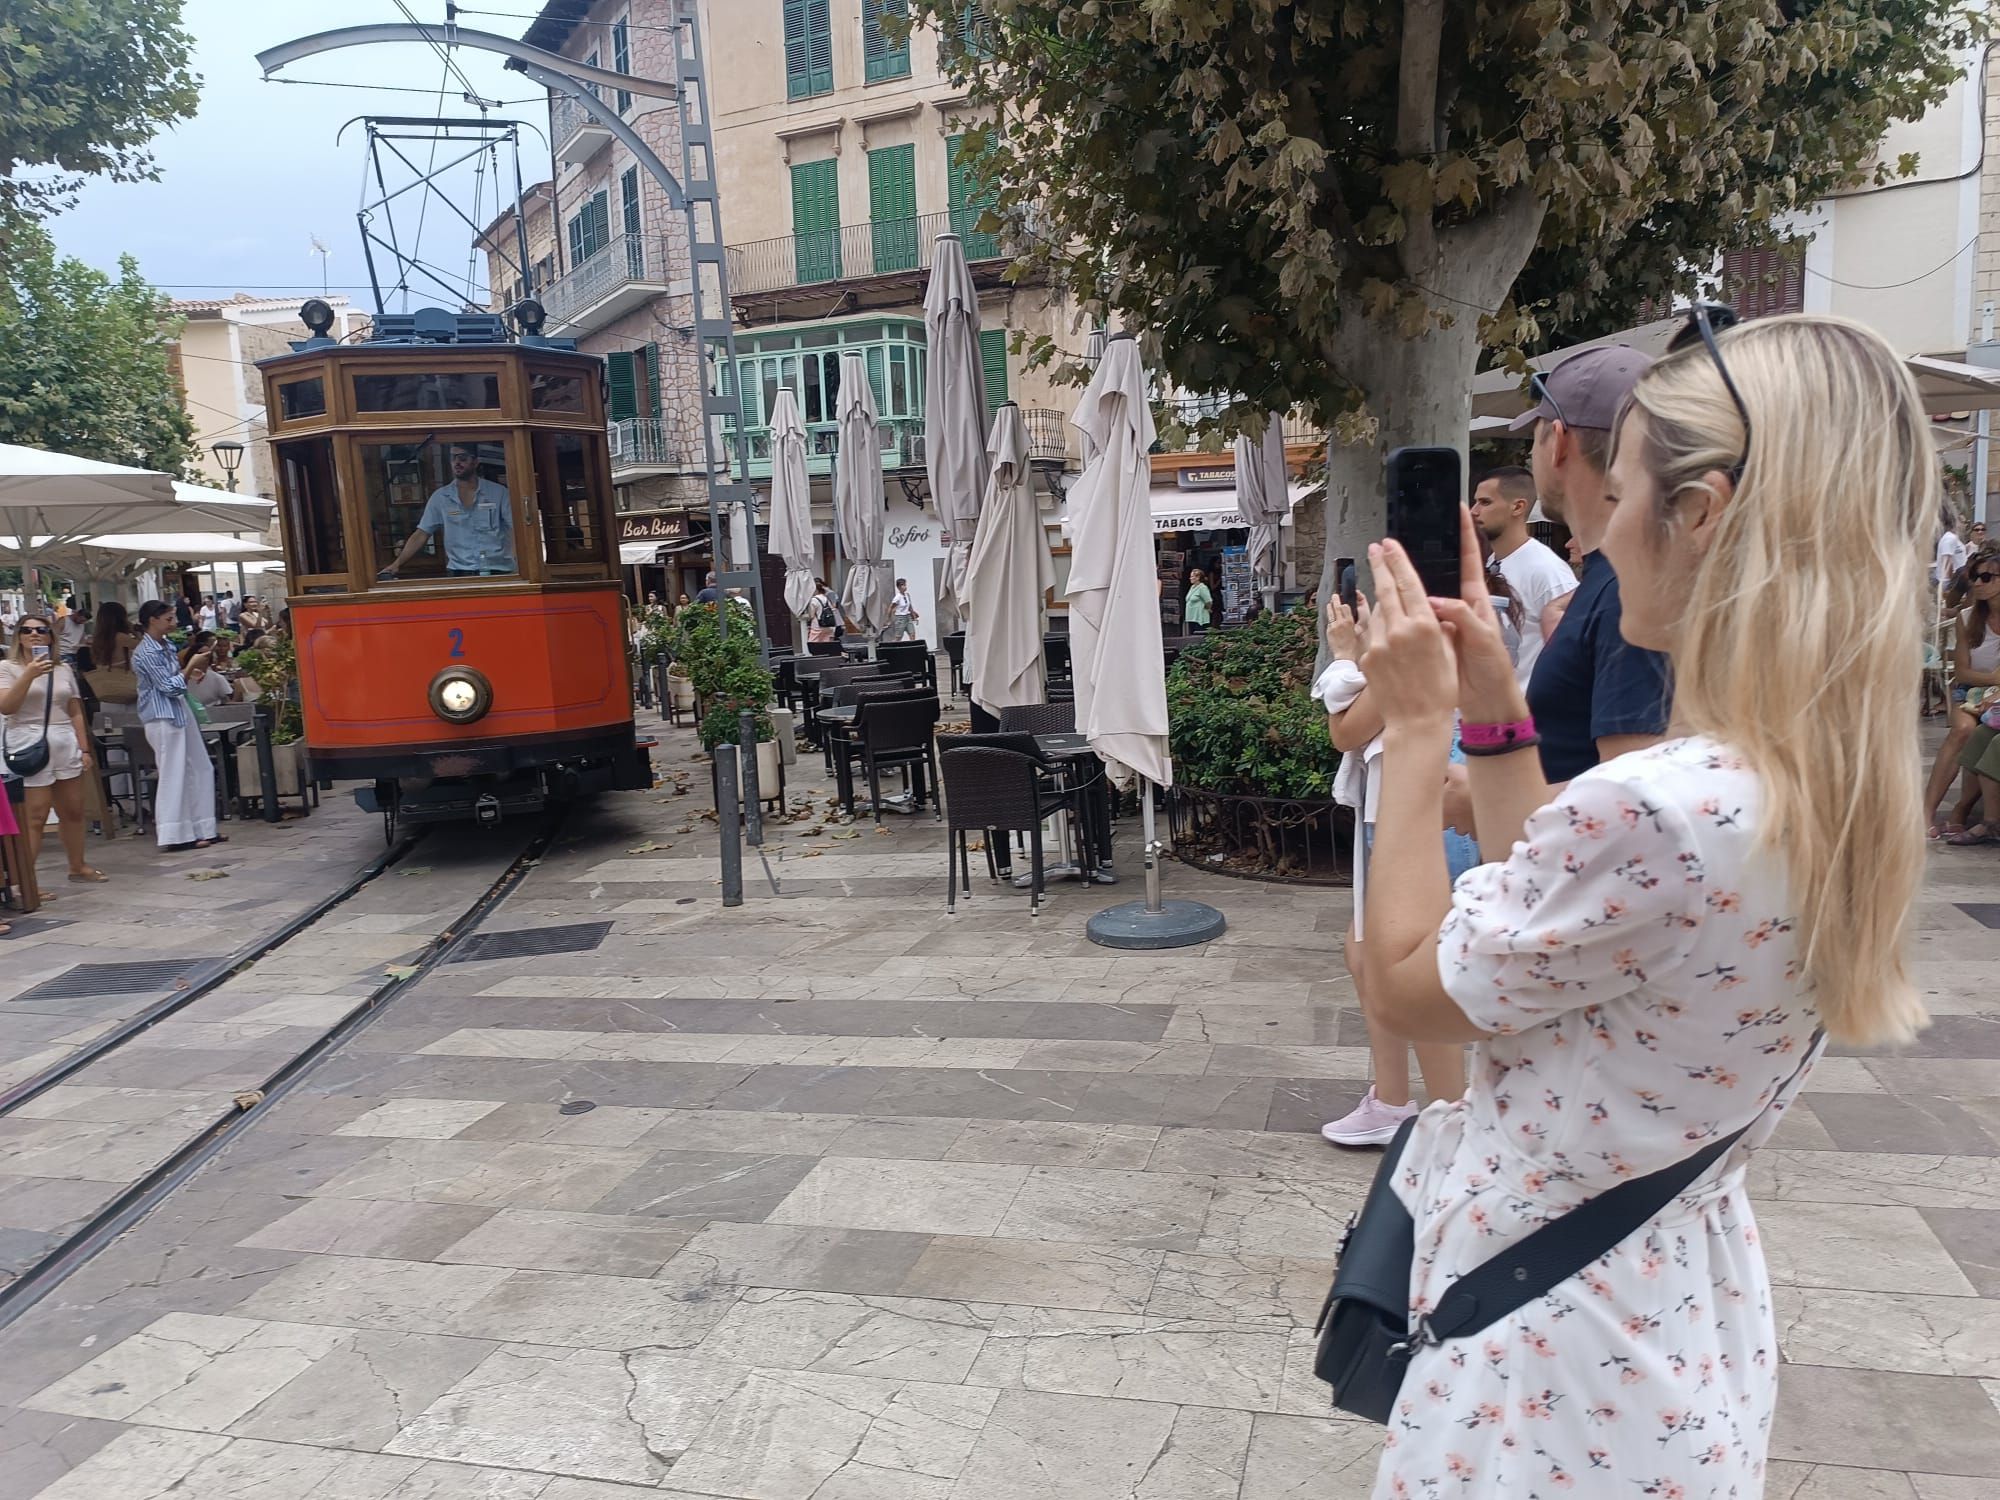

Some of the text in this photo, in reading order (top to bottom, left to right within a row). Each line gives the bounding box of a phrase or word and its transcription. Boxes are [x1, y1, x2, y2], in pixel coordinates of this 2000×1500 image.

[623, 518, 681, 537] Bar Bini
[1155, 517, 1203, 528] TABACS
[448, 628, 465, 657] 2
